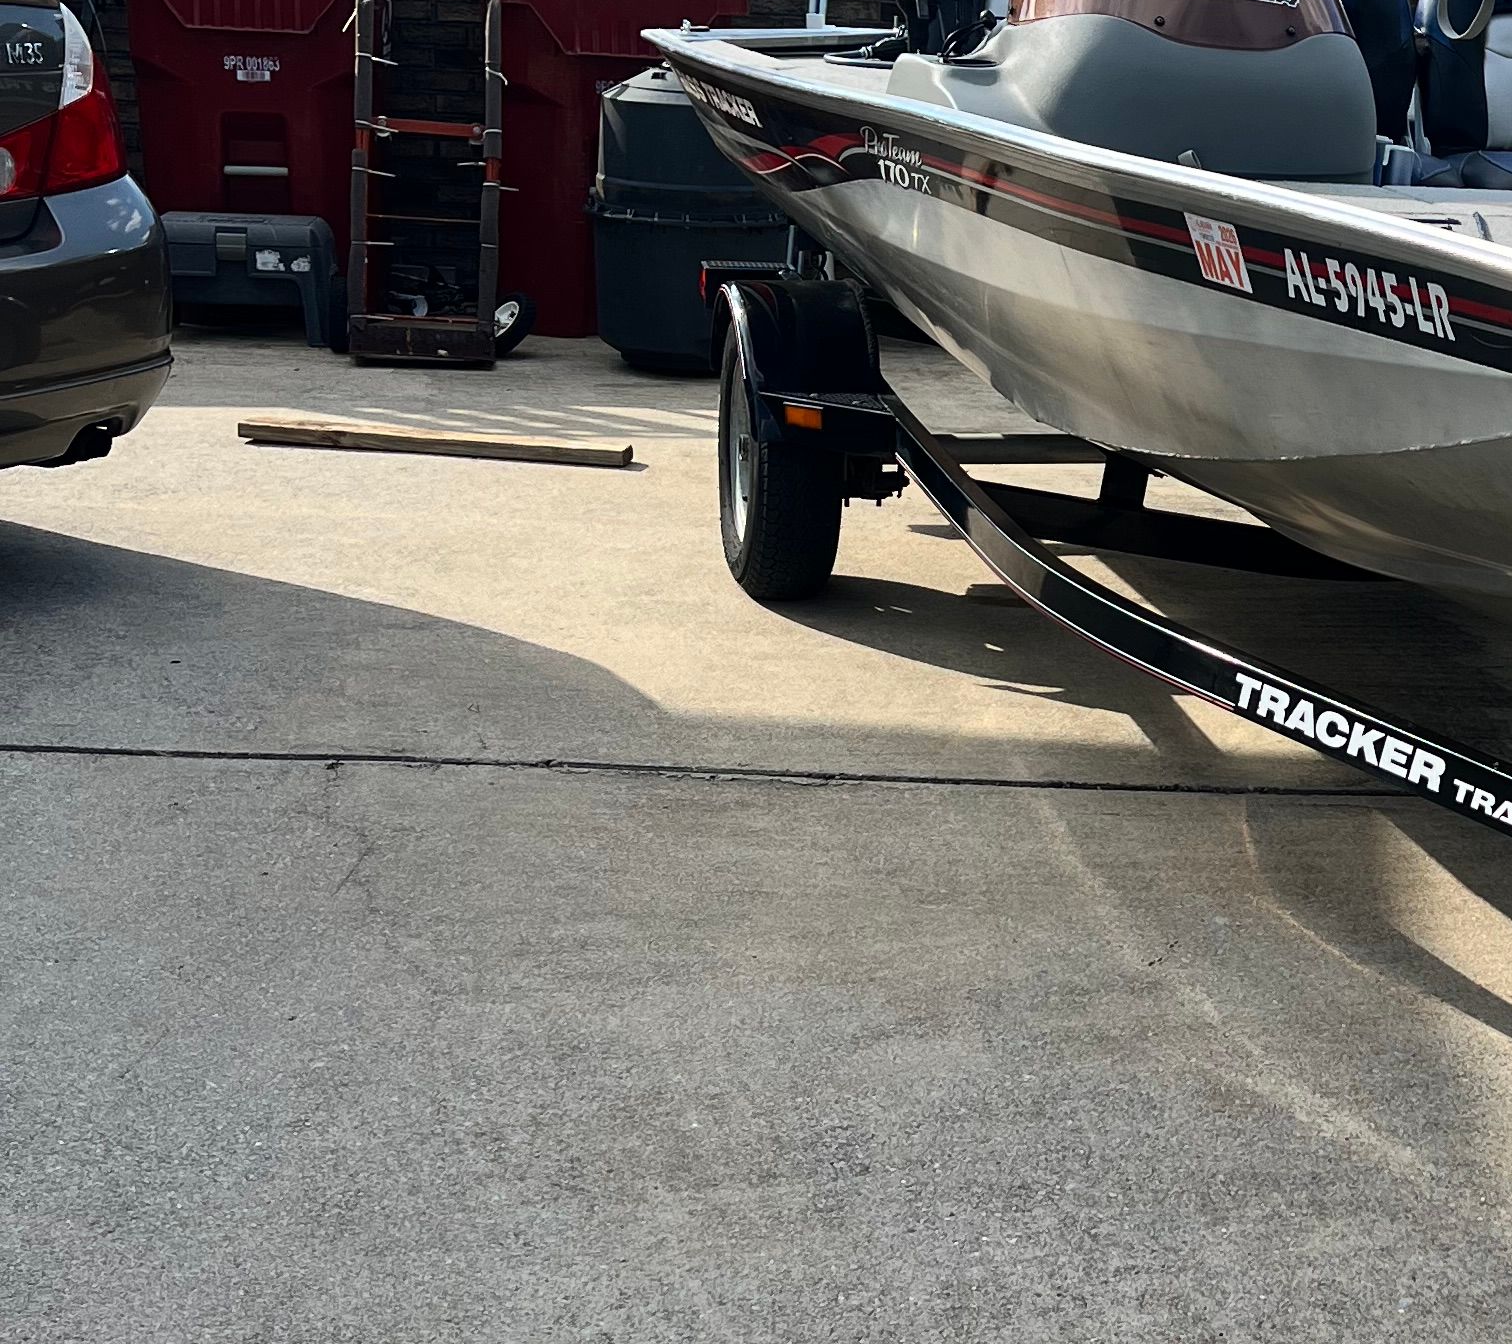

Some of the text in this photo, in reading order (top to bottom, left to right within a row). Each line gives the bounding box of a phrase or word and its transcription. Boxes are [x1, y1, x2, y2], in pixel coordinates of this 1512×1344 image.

[5, 42, 44, 64] M35
[700, 80, 764, 129] TRACKER
[878, 159, 932, 195] 170 TX
[1194, 240, 1245, 289] MAY
[1283, 247, 1456, 342] AL-5945-LR
[1235, 672, 1446, 793] TRACKER
